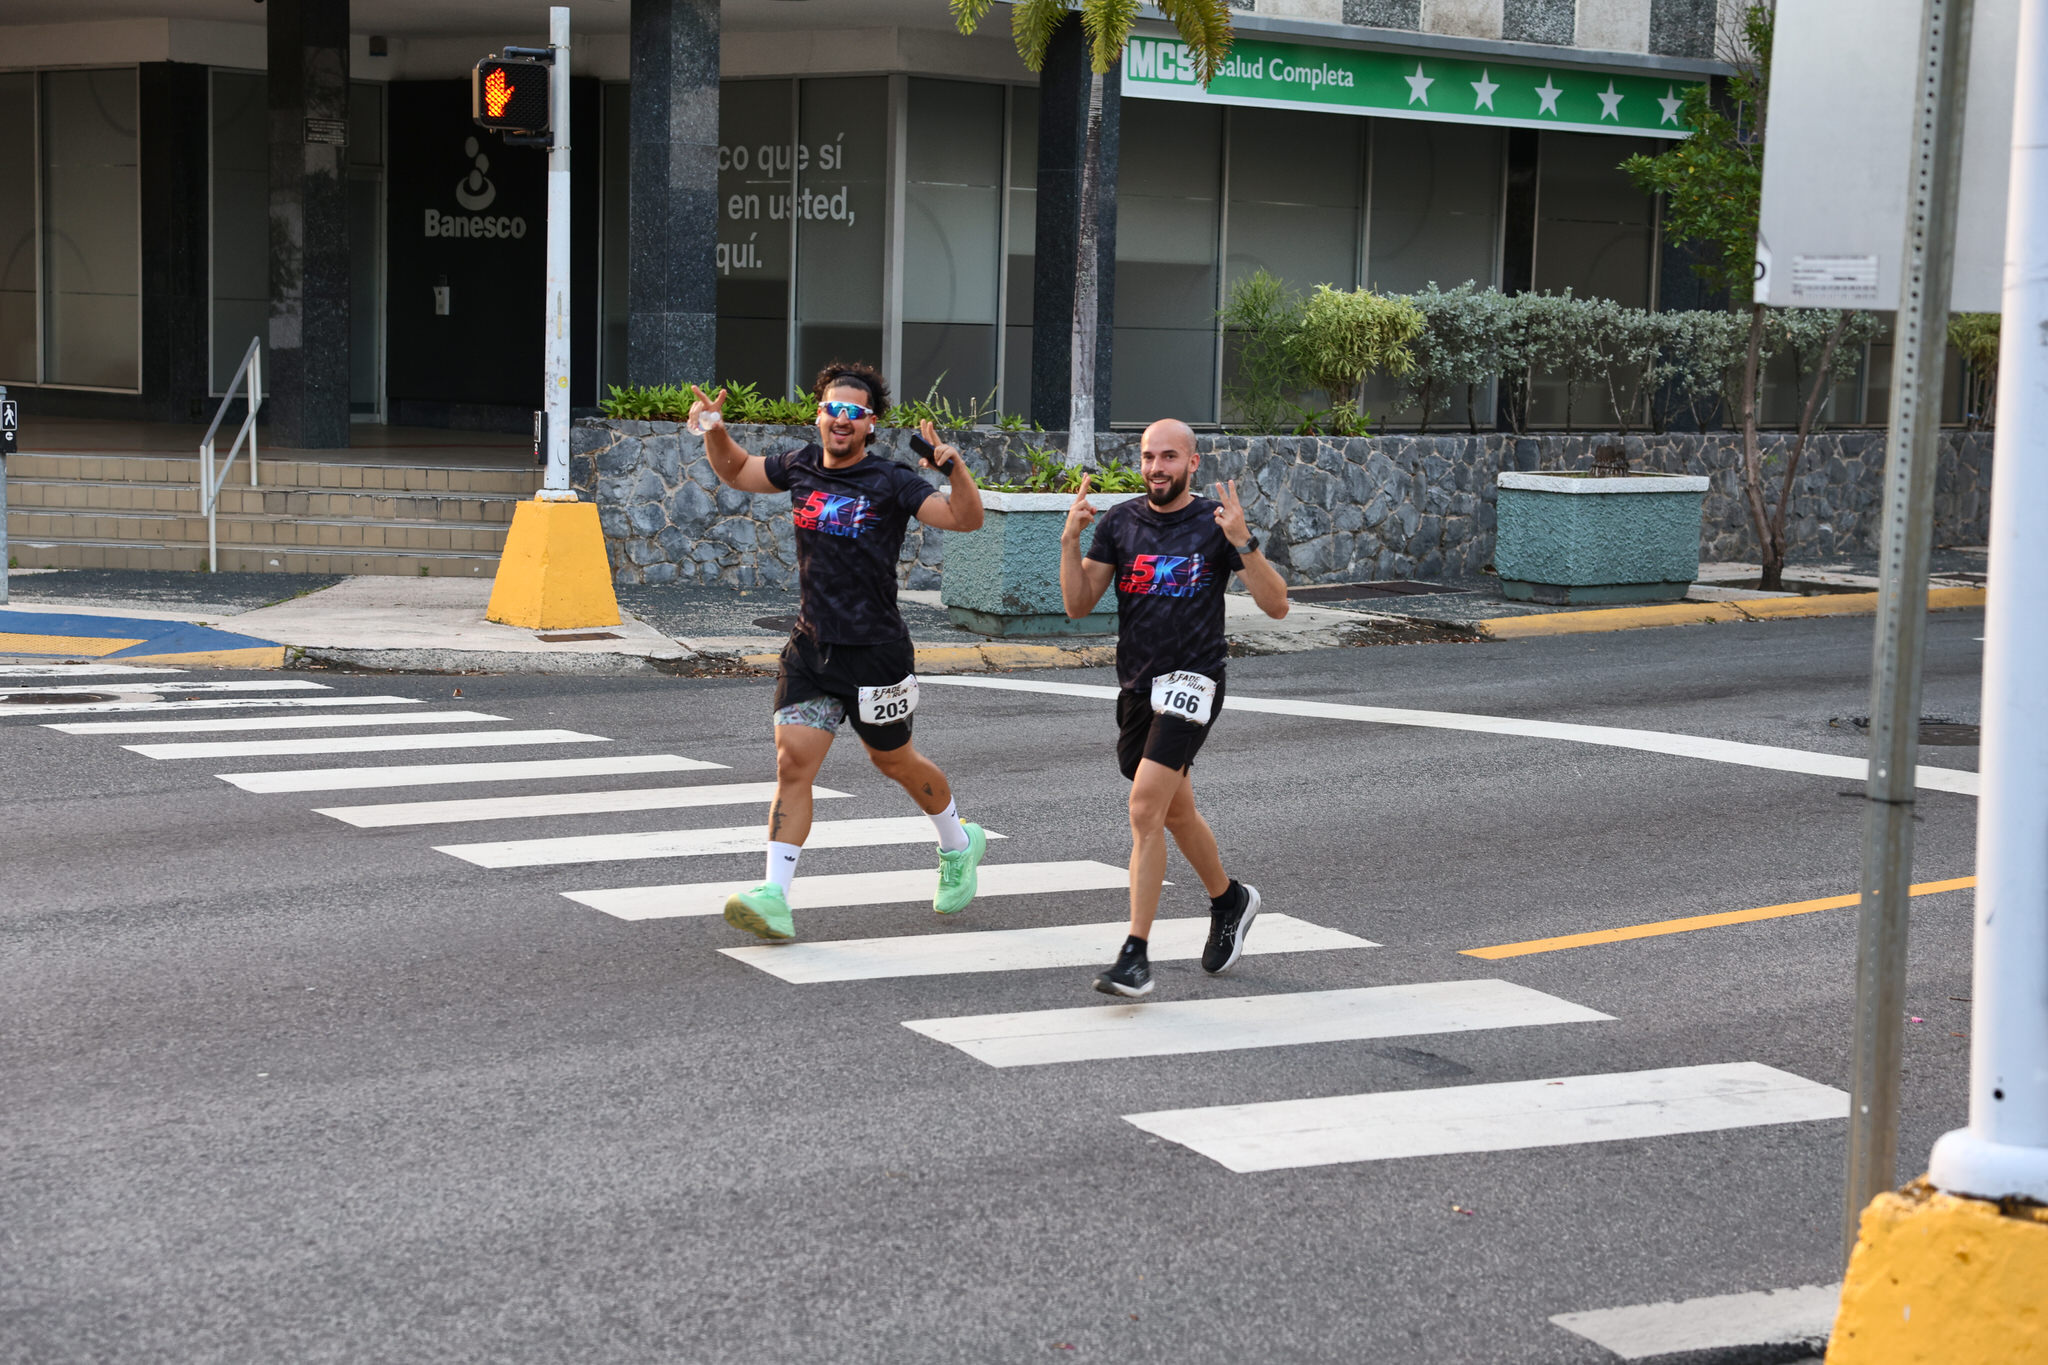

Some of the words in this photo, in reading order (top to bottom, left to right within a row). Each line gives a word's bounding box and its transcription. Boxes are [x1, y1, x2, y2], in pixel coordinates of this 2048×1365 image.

[1130, 39, 1196, 82] MCS
[1269, 58, 1354, 91] Completa
[758, 144, 810, 178] que
[819, 132, 845, 170] sí
[728, 194, 760, 220] en
[424, 208, 527, 239] Banesco
[801, 490, 856, 524] 5K
[1131, 554, 1189, 586] 5K
[874, 698, 908, 720] 203
[1164, 690, 1200, 714] 166
